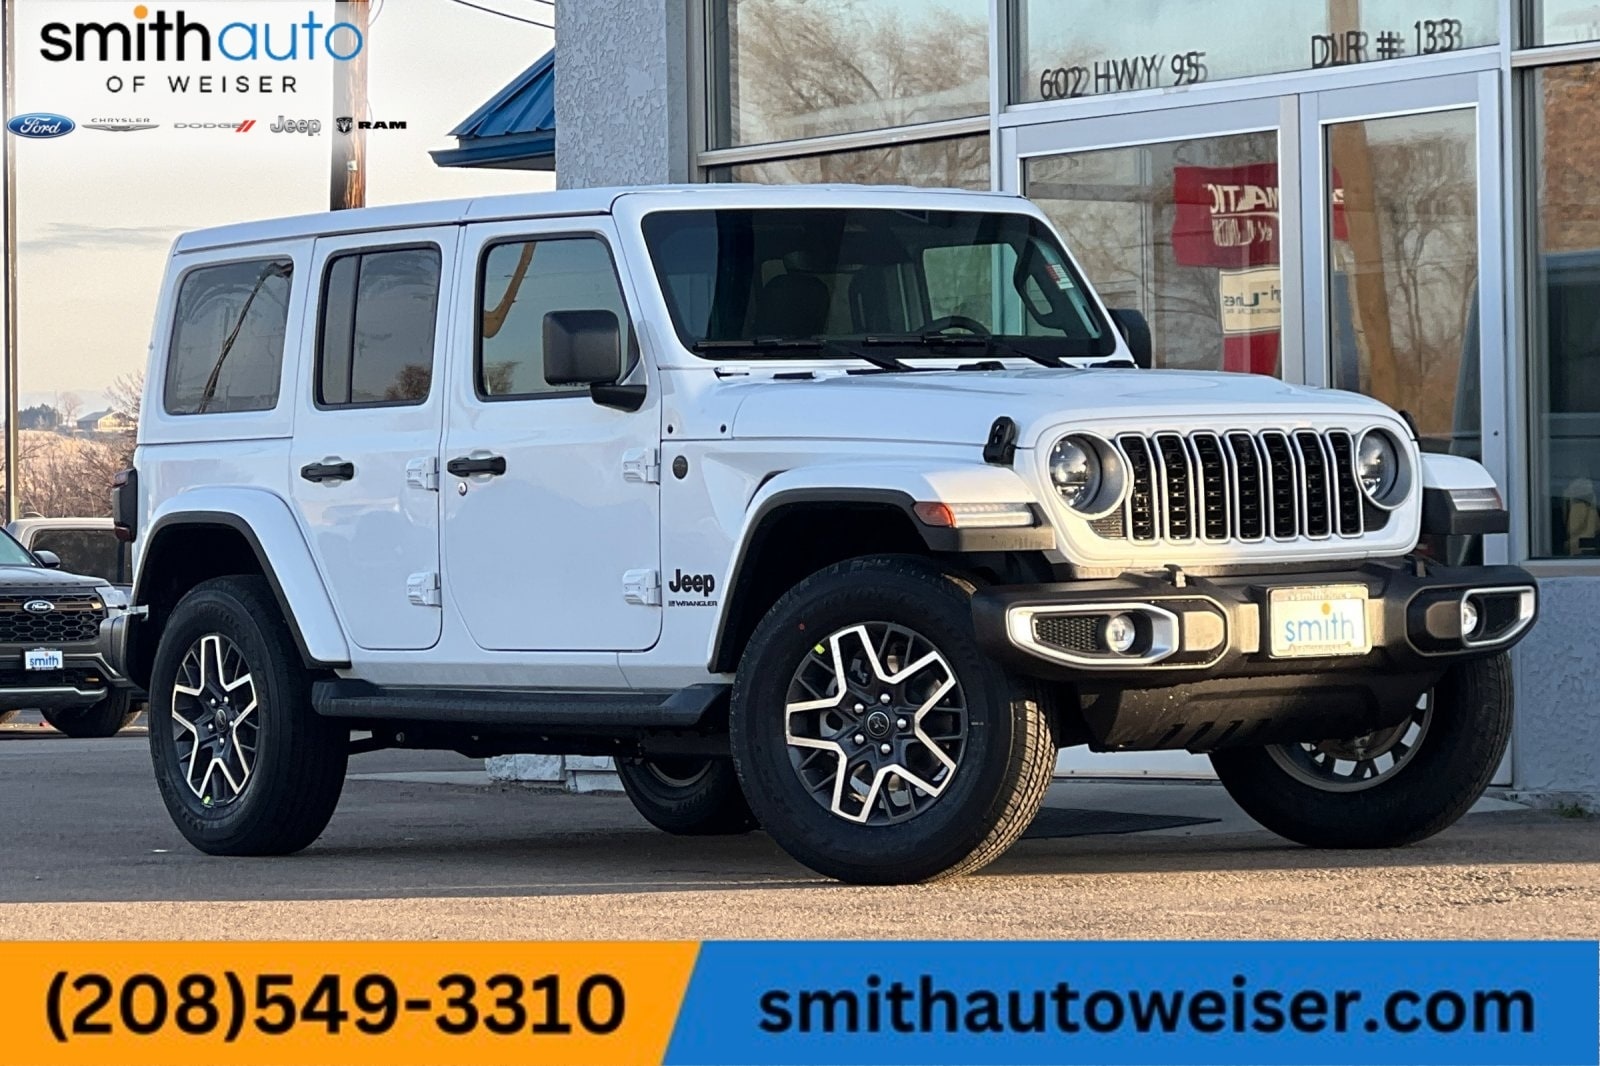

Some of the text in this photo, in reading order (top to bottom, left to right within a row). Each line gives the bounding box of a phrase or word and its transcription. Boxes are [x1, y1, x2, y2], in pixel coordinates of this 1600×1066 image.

[1040, 51, 1200, 100] 602 HWY 95
[668, 568, 715, 597] Jeep
[1285, 603, 1355, 642] smith
[29, 652, 59, 667] smith
